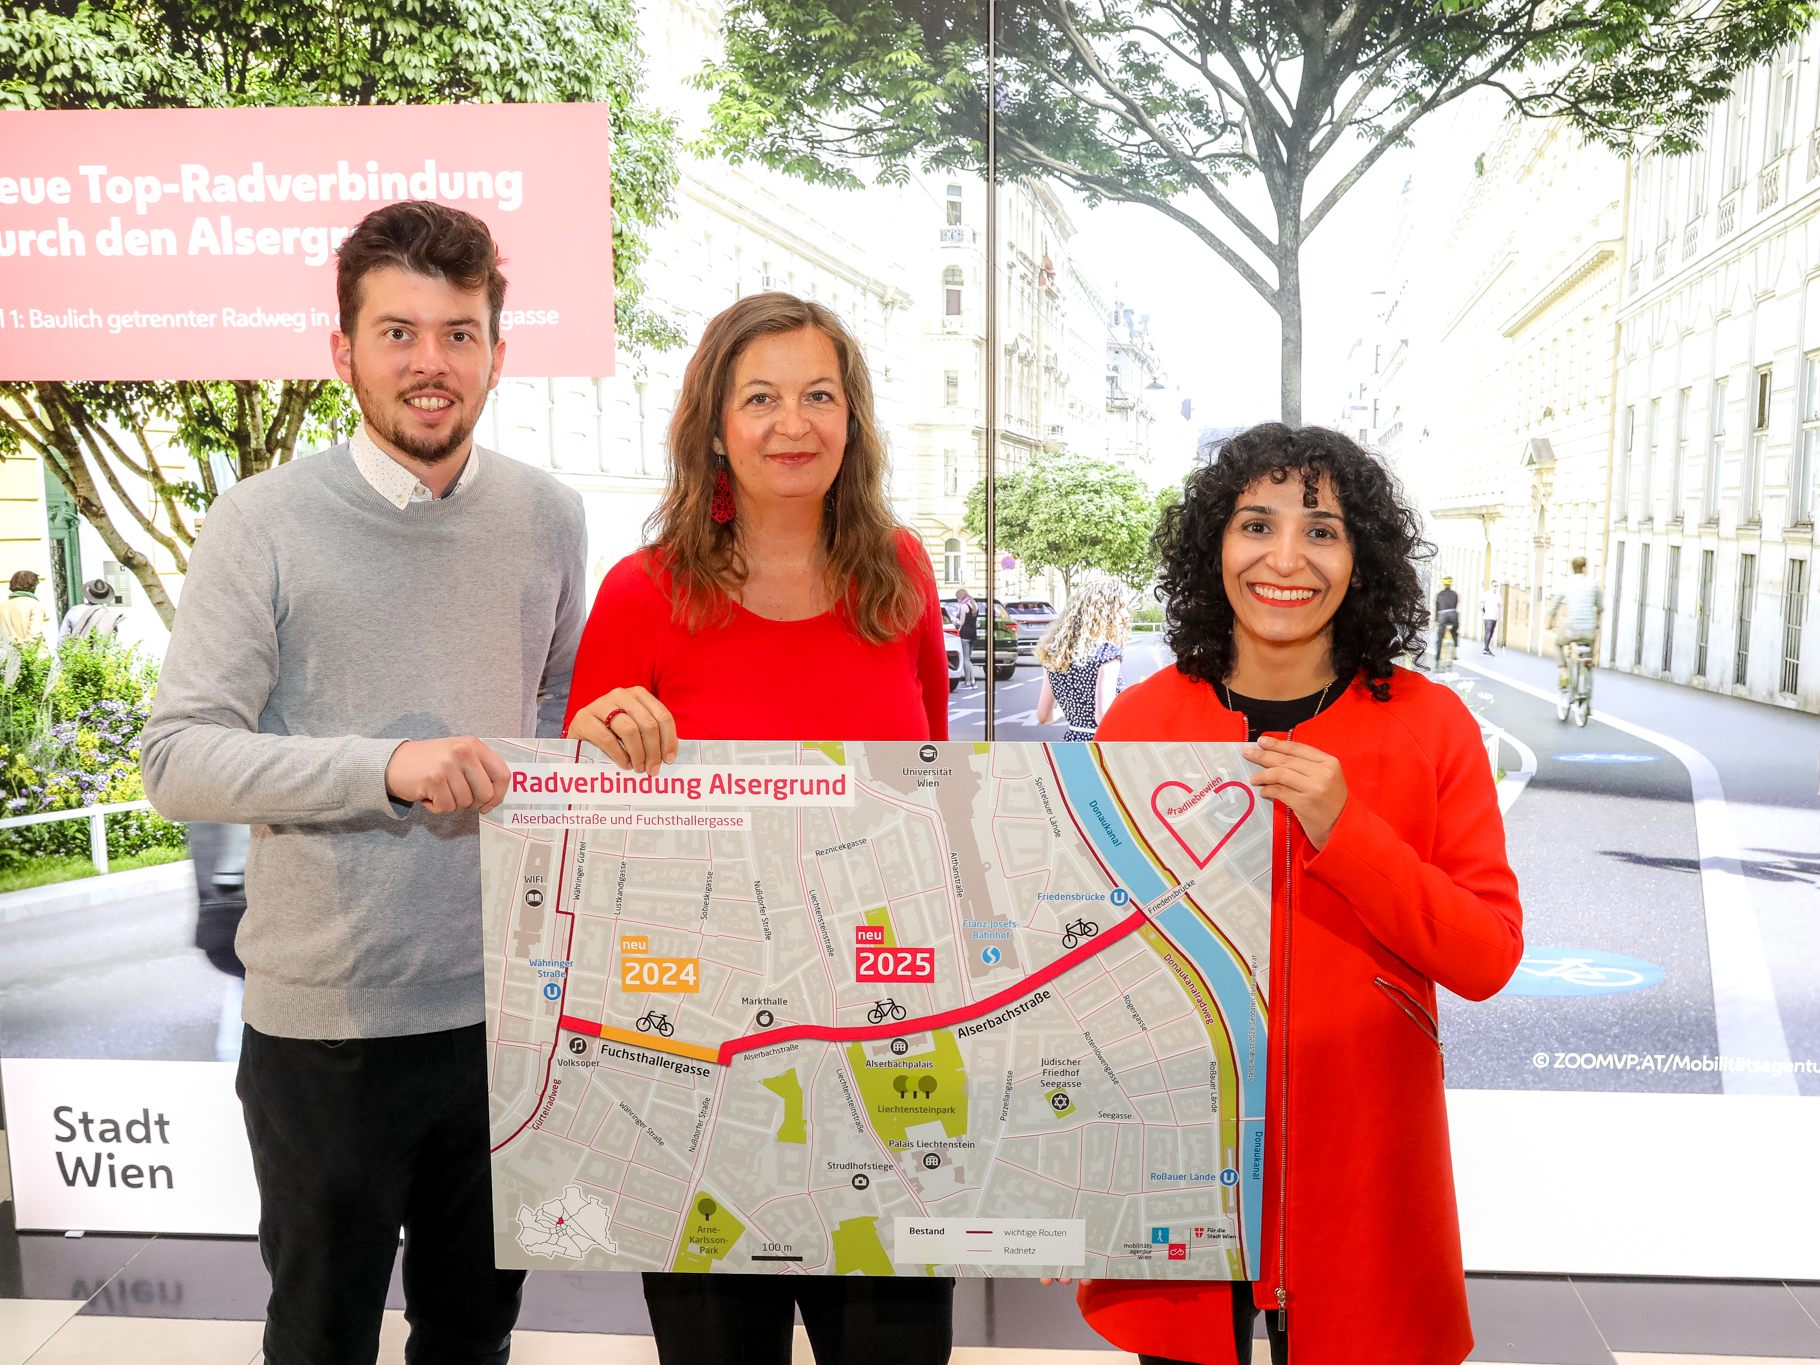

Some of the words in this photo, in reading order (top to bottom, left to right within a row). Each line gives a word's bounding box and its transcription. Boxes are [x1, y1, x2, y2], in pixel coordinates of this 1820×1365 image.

[78, 159, 524, 215] Top-Radverbindung
[96, 216, 178, 256] den
[188, 215, 357, 266] Alsergr
[9, 309, 25, 328] 1:
[29, 307, 103, 328] Baulich
[107, 310, 217, 334] getrennter
[222, 307, 306, 333] Radweg
[310, 307, 330, 327] in
[500, 309, 560, 331] gasse
[902, 767, 952, 777] Universität
[511, 771, 702, 800] Radverbindung
[709, 773, 846, 801] Alsergrund
[917, 779, 940, 788] Wien
[1166, 775, 1223, 816] #radliebewien
[1034, 776, 1053, 819] Spittelauer
[1049, 815, 1061, 838] Lände
[511, 812, 607, 826] Alserbachstraße
[610, 813, 633, 826] und
[636, 814, 744, 829] Fuchsthallergasse
[1088, 799, 1123, 848] Donaukanal
[815, 837, 868, 857] Reznicekgasse
[524, 875, 544, 884] WIFI
[572, 864, 585, 901] Währinger
[579, 841, 587, 864] Gürtel
[950, 851, 964, 898] Althanstraße
[614, 861, 627, 916] Lustkandlgasse
[700, 871, 714, 920] Sobieskigasse
[1037, 891, 1105, 901] Friedensbrücke
[1147, 879, 1196, 915] Friedensbrücke
[753, 880, 767, 916] Nußdorfer
[761, 917, 772, 941] Straße
[809, 889, 835, 957] Liechtensteinstraße
[962, 919, 1020, 929] Franz-Josefs-
[622, 939, 647, 950] neu
[857, 930, 882, 941] neu
[972, 930, 1010, 940] Bahnhof
[529, 959, 573, 969] Währinger
[537, 969, 567, 978] Straße
[624, 961, 698, 986] 2024
[858, 952, 932, 977] 2025
[1162, 952, 1215, 1026] Donaukanalradweg
[741, 997, 788, 1006] Markthalle
[957, 989, 1052, 1039] Alserbachstraße
[1122, 994, 1148, 1032] Rogergasse
[557, 1058, 600, 1068] Volksoper
[600, 1044, 711, 1078] Fuchsthallergasse
[743, 1043, 800, 1062] Alserbachstraße
[1040, 1057, 1081, 1067] Jüdischer
[865, 1060, 934, 1069] Alserbachpalais
[1042, 1068, 1080, 1077] Friedhof
[1209, 1061, 1218, 1090] Roßauer
[1040, 1079, 1082, 1089] Seegasse
[531, 1078, 562, 1131] Gürtelradweg
[835, 1068, 864, 1134] Liechtensteinstraße
[1000, 1070, 1014, 1122] Porzellangasse
[1210, 1091, 1218, 1113] Lände
[877, 1105, 956, 1115] Liechtensteinpark
[1098, 1110, 1132, 1121] Seegasse
[53, 1105, 170, 1144] Stadt
[618, 1100, 648, 1131] Währinger
[645, 1127, 665, 1147] Straße
[688, 1119, 705, 1153] Nußdorfer
[698, 1096, 711, 1120] Straße
[888, 1139, 915, 1148] Palais
[916, 1140, 976, 1149] Liechtenstein
[1252, 1130, 1264, 1180] Donaukanal
[55, 1151, 174, 1189] Wien
[827, 1161, 894, 1171] Strudlhofstiege
[1150, 1173, 1187, 1181] Roßauer
[1189, 1172, 1216, 1181] Lände
[689, 1235, 729, 1244] Karlsson-
[696, 1226, 721, 1234] Arne-
[909, 1227, 945, 1236] Bestand
[1004, 1228, 1037, 1238] wichtige
[1039, 1228, 1067, 1237] Routen
[699, 1246, 719, 1255] Park
[762, 1243, 781, 1252] 100
[783, 1244, 792, 1252] m
[1003, 1246, 1036, 1255] Radnetz
